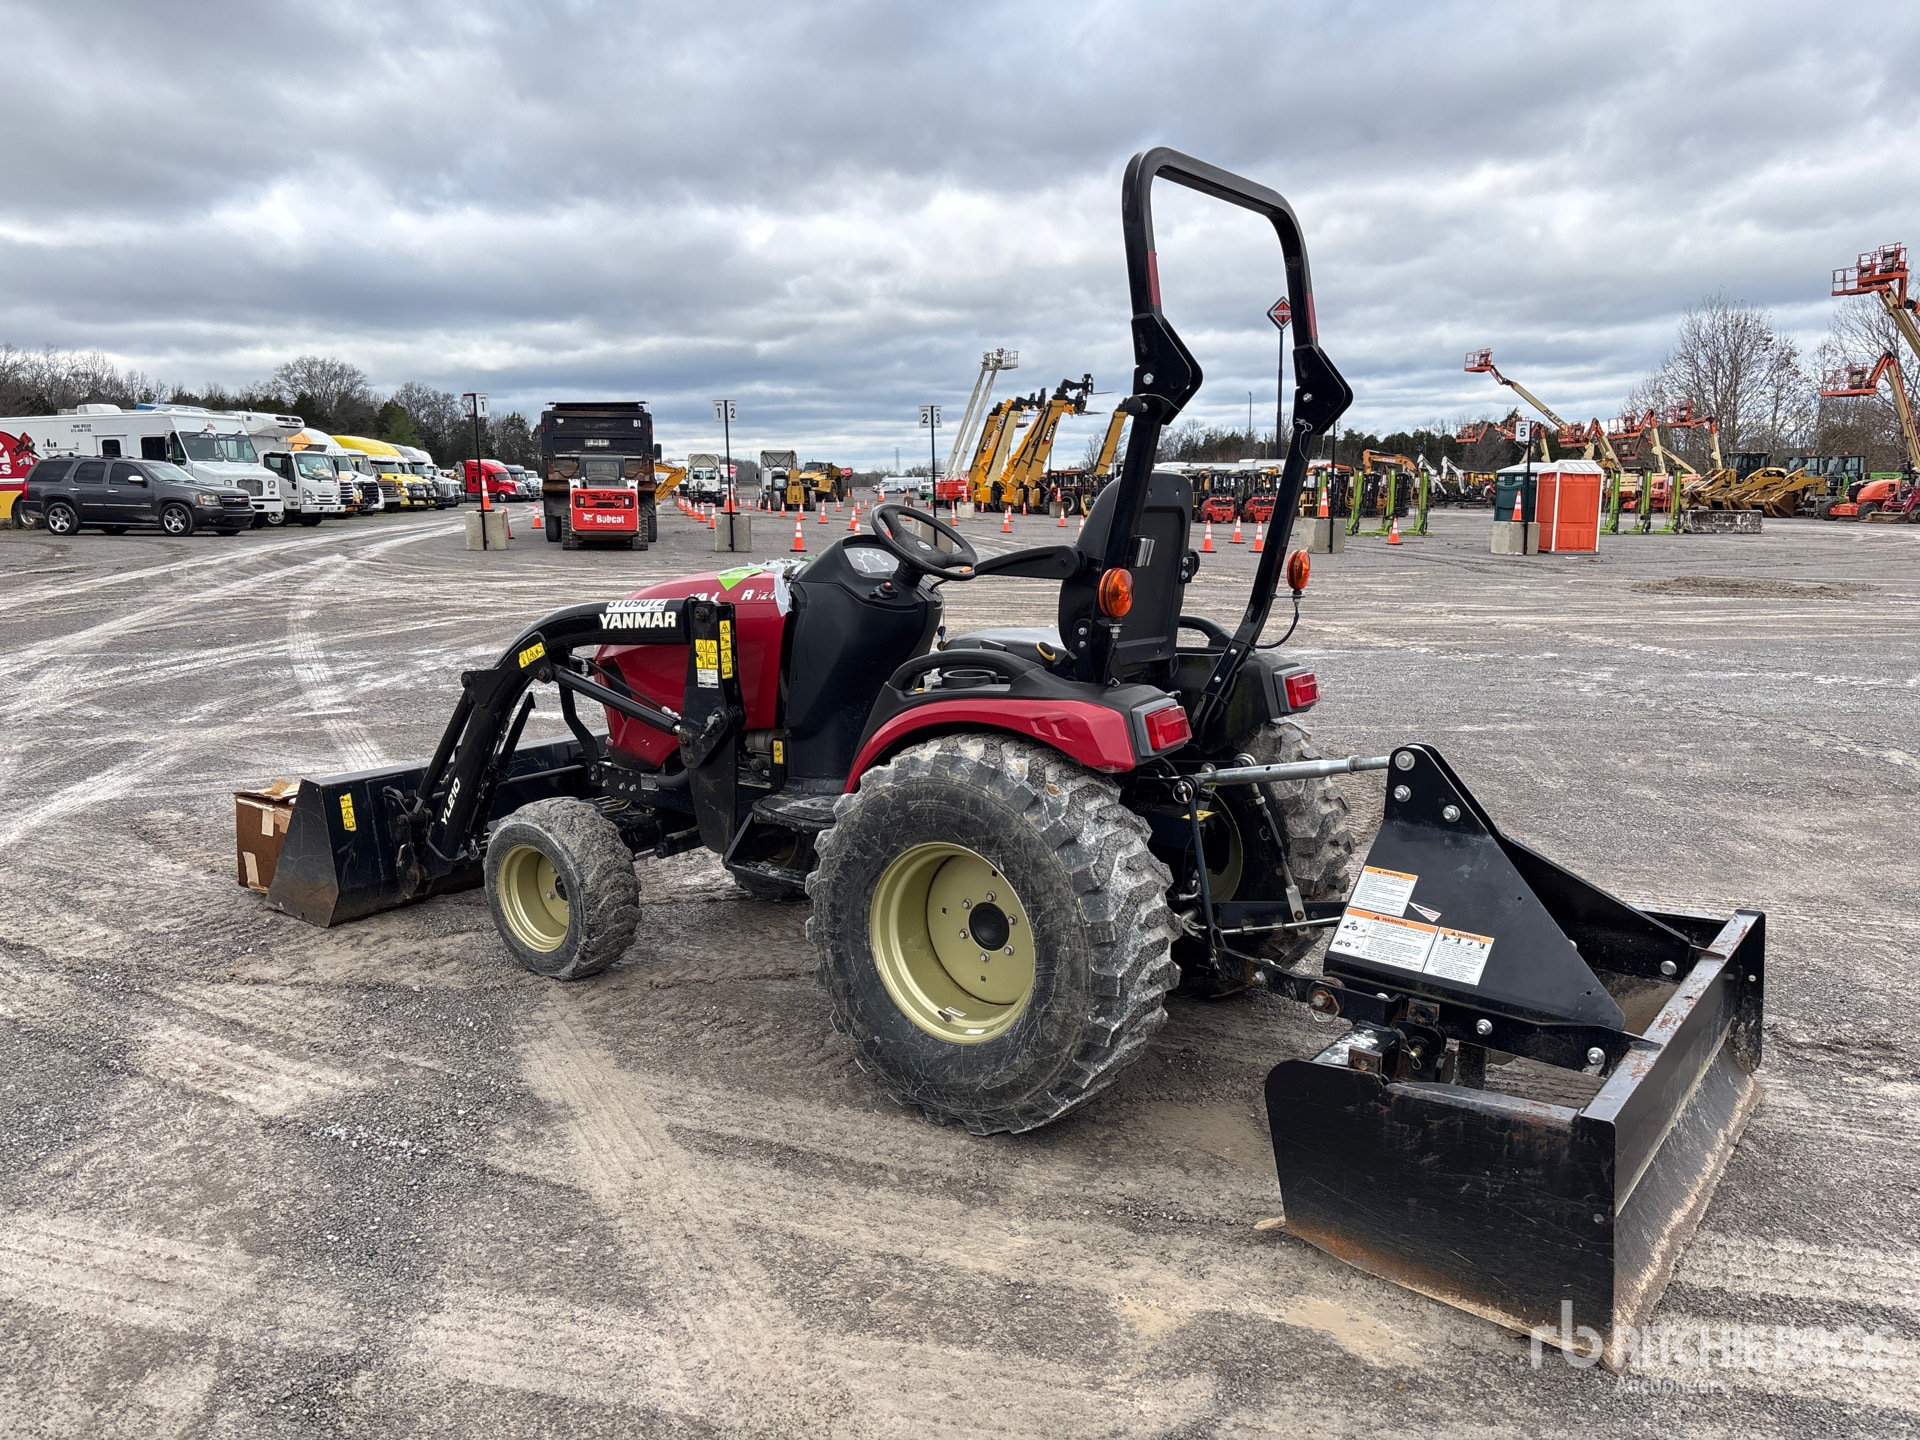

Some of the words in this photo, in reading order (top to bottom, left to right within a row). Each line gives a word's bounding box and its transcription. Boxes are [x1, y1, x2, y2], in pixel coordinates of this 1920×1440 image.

[730, 408, 736, 418] 2
[633, 419, 641, 428] 81
[922, 413, 928, 424] 2
[936, 413, 940, 424] 3
[1520, 428, 1526, 437] 5
[0, 464, 12, 475] S
[596, 515, 624, 524] Bobcat
[599, 612, 676, 629] YANMAR
[441, 777, 460, 825] YL210
[1382, 917, 1407, 926] WARNING
